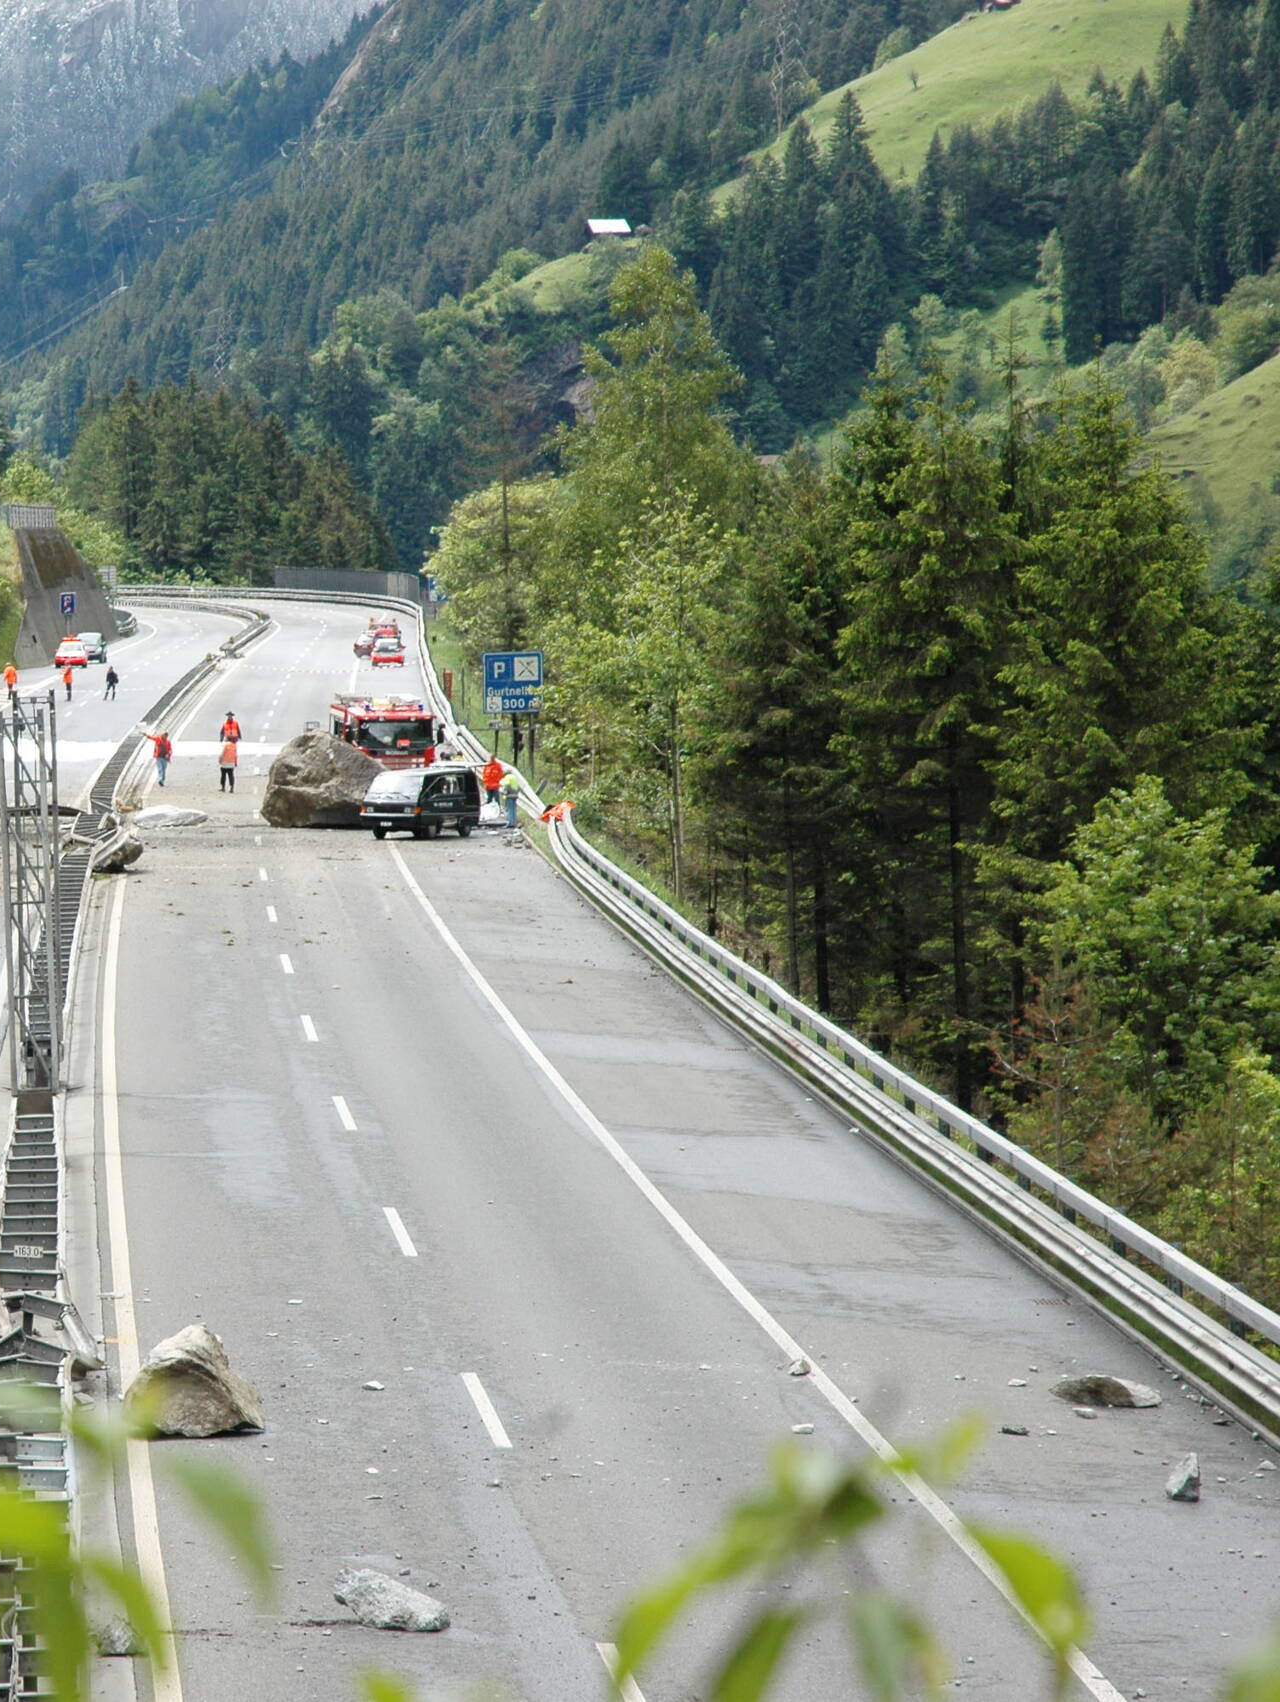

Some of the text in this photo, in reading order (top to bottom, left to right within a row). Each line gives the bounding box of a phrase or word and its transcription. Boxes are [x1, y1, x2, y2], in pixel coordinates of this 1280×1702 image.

[494, 662, 505, 679] P
[487, 686, 537, 697] Gurtnell
[503, 698, 525, 709] 300
